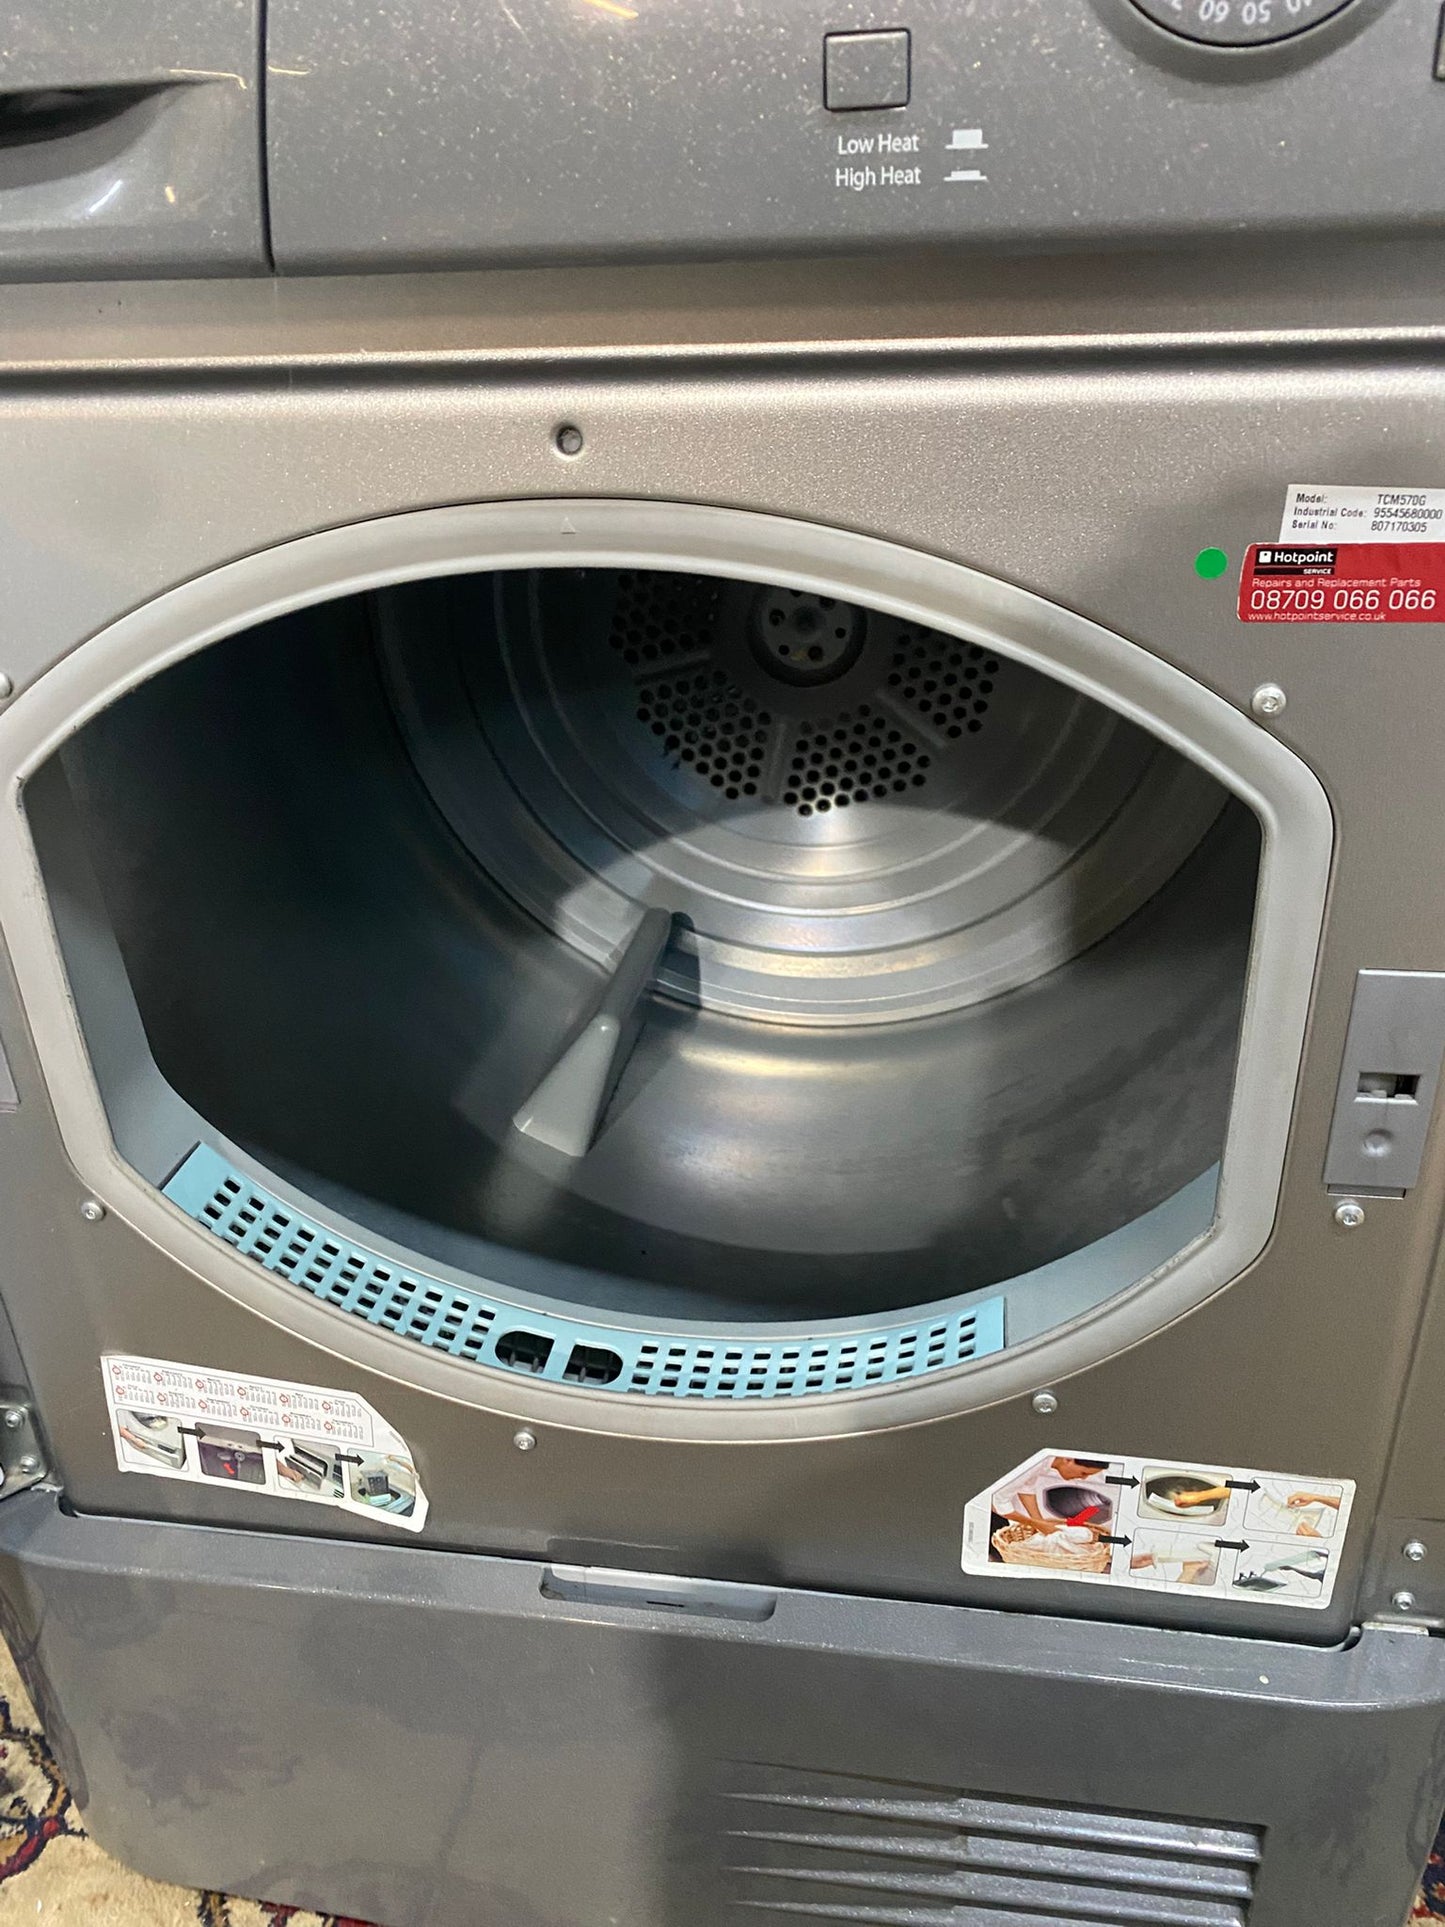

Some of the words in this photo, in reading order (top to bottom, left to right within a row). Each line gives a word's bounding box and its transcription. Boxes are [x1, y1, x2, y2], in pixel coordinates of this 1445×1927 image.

[1200, 0, 1229, 23] 60
[1242, 3, 1271, 25] 50
[838, 135, 874, 155] Low
[878, 133, 920, 153] Heat
[835, 165, 876, 191] High
[880, 165, 921, 186] Heat
[1296, 493, 1327, 504] Model:
[1377, 494, 1427, 506] TCM570G
[1293, 507, 1337, 518] Industrial
[1340, 508, 1367, 518] Code:
[1292, 520, 1318, 530] Serial
[1321, 520, 1337, 531] No:
[1371, 520, 1428, 533] 807170305
[1273, 550, 1333, 565] Hotpoint
[1252, 577, 1292, 589] Repairs
[1294, 578, 1314, 588] and
[1317, 578, 1387, 589] Replacement
[1390, 578, 1421, 588] Parts
[1250, 589, 1325, 610] 08709
[1333, 589, 1380, 610] 066
[1388, 589, 1436, 610] 066
[1248, 611, 1387, 622] www.hotpointservice.co.uk
